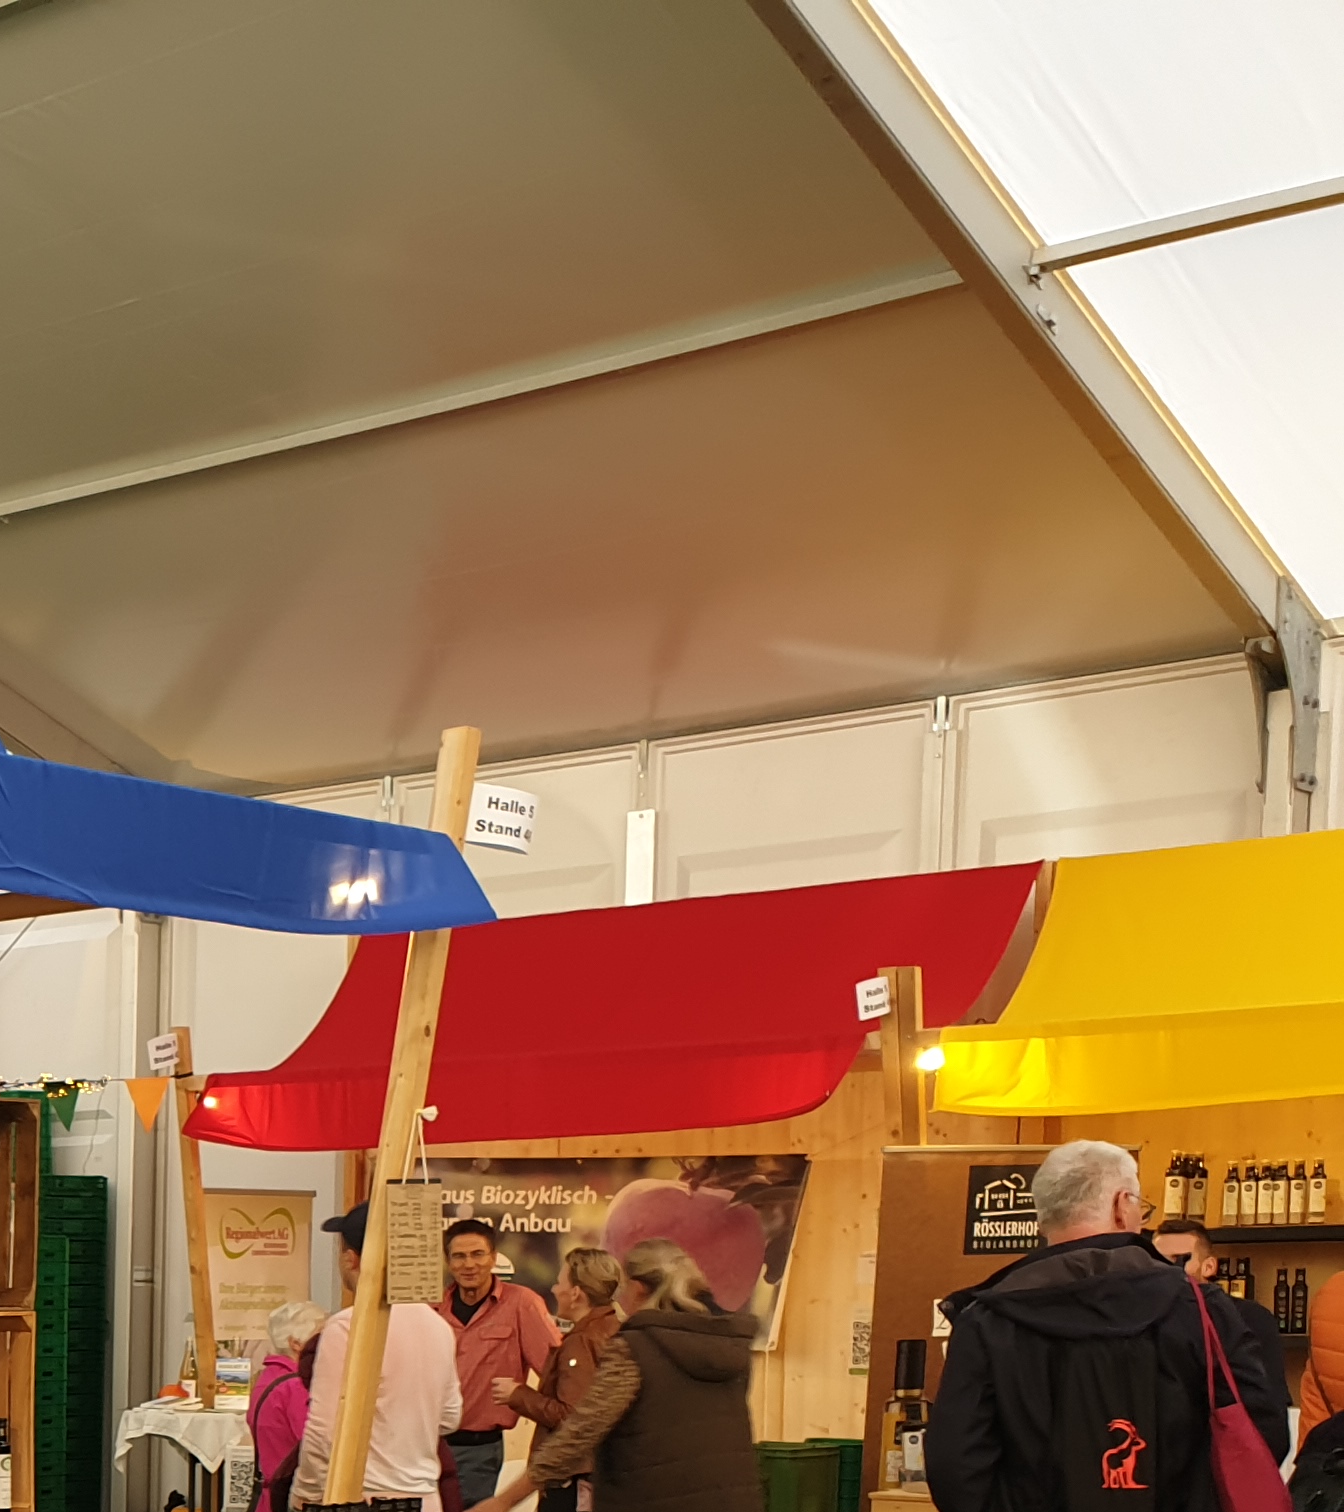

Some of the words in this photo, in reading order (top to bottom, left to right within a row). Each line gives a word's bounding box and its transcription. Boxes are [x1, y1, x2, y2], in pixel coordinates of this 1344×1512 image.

[487, 796, 527, 816] Halle
[474, 819, 522, 838] Stand
[480, 1185, 597, 1210] Biozyklisch
[499, 1213, 572, 1233] Anbau
